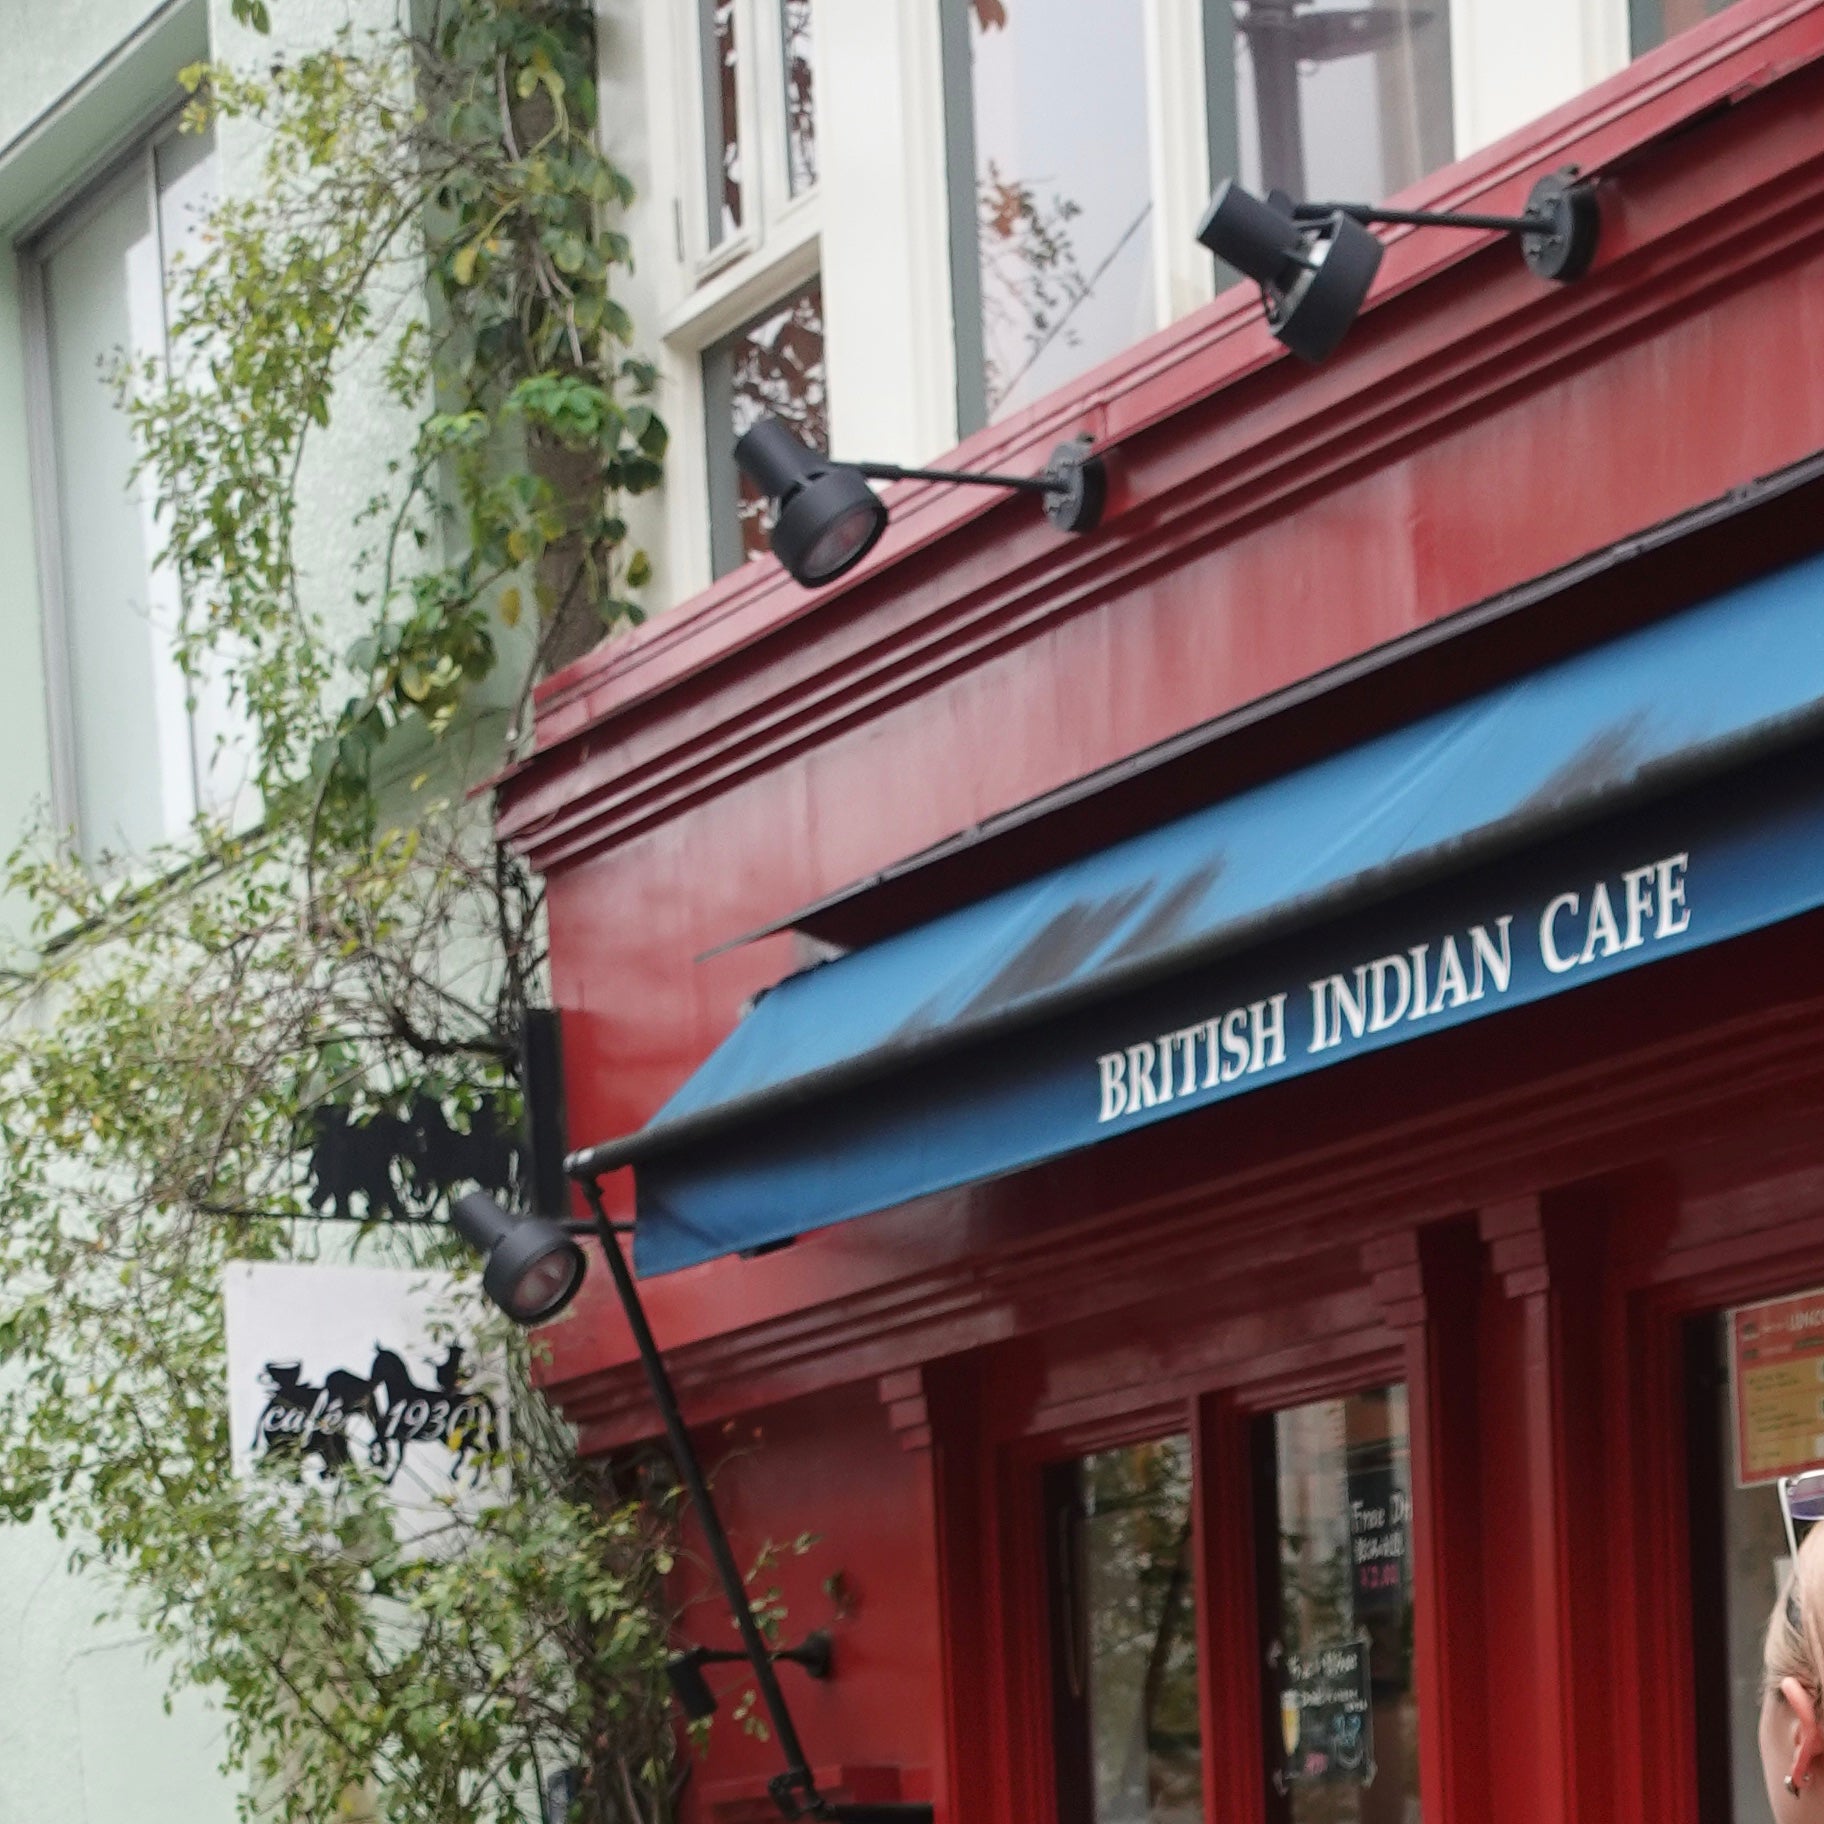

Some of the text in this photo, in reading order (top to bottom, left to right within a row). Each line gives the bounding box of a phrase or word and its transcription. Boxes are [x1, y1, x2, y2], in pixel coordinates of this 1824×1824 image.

[1097, 852, 1690, 1122] BRITISH INDIAN CAFE
[263, 1389, 345, 1448] café
